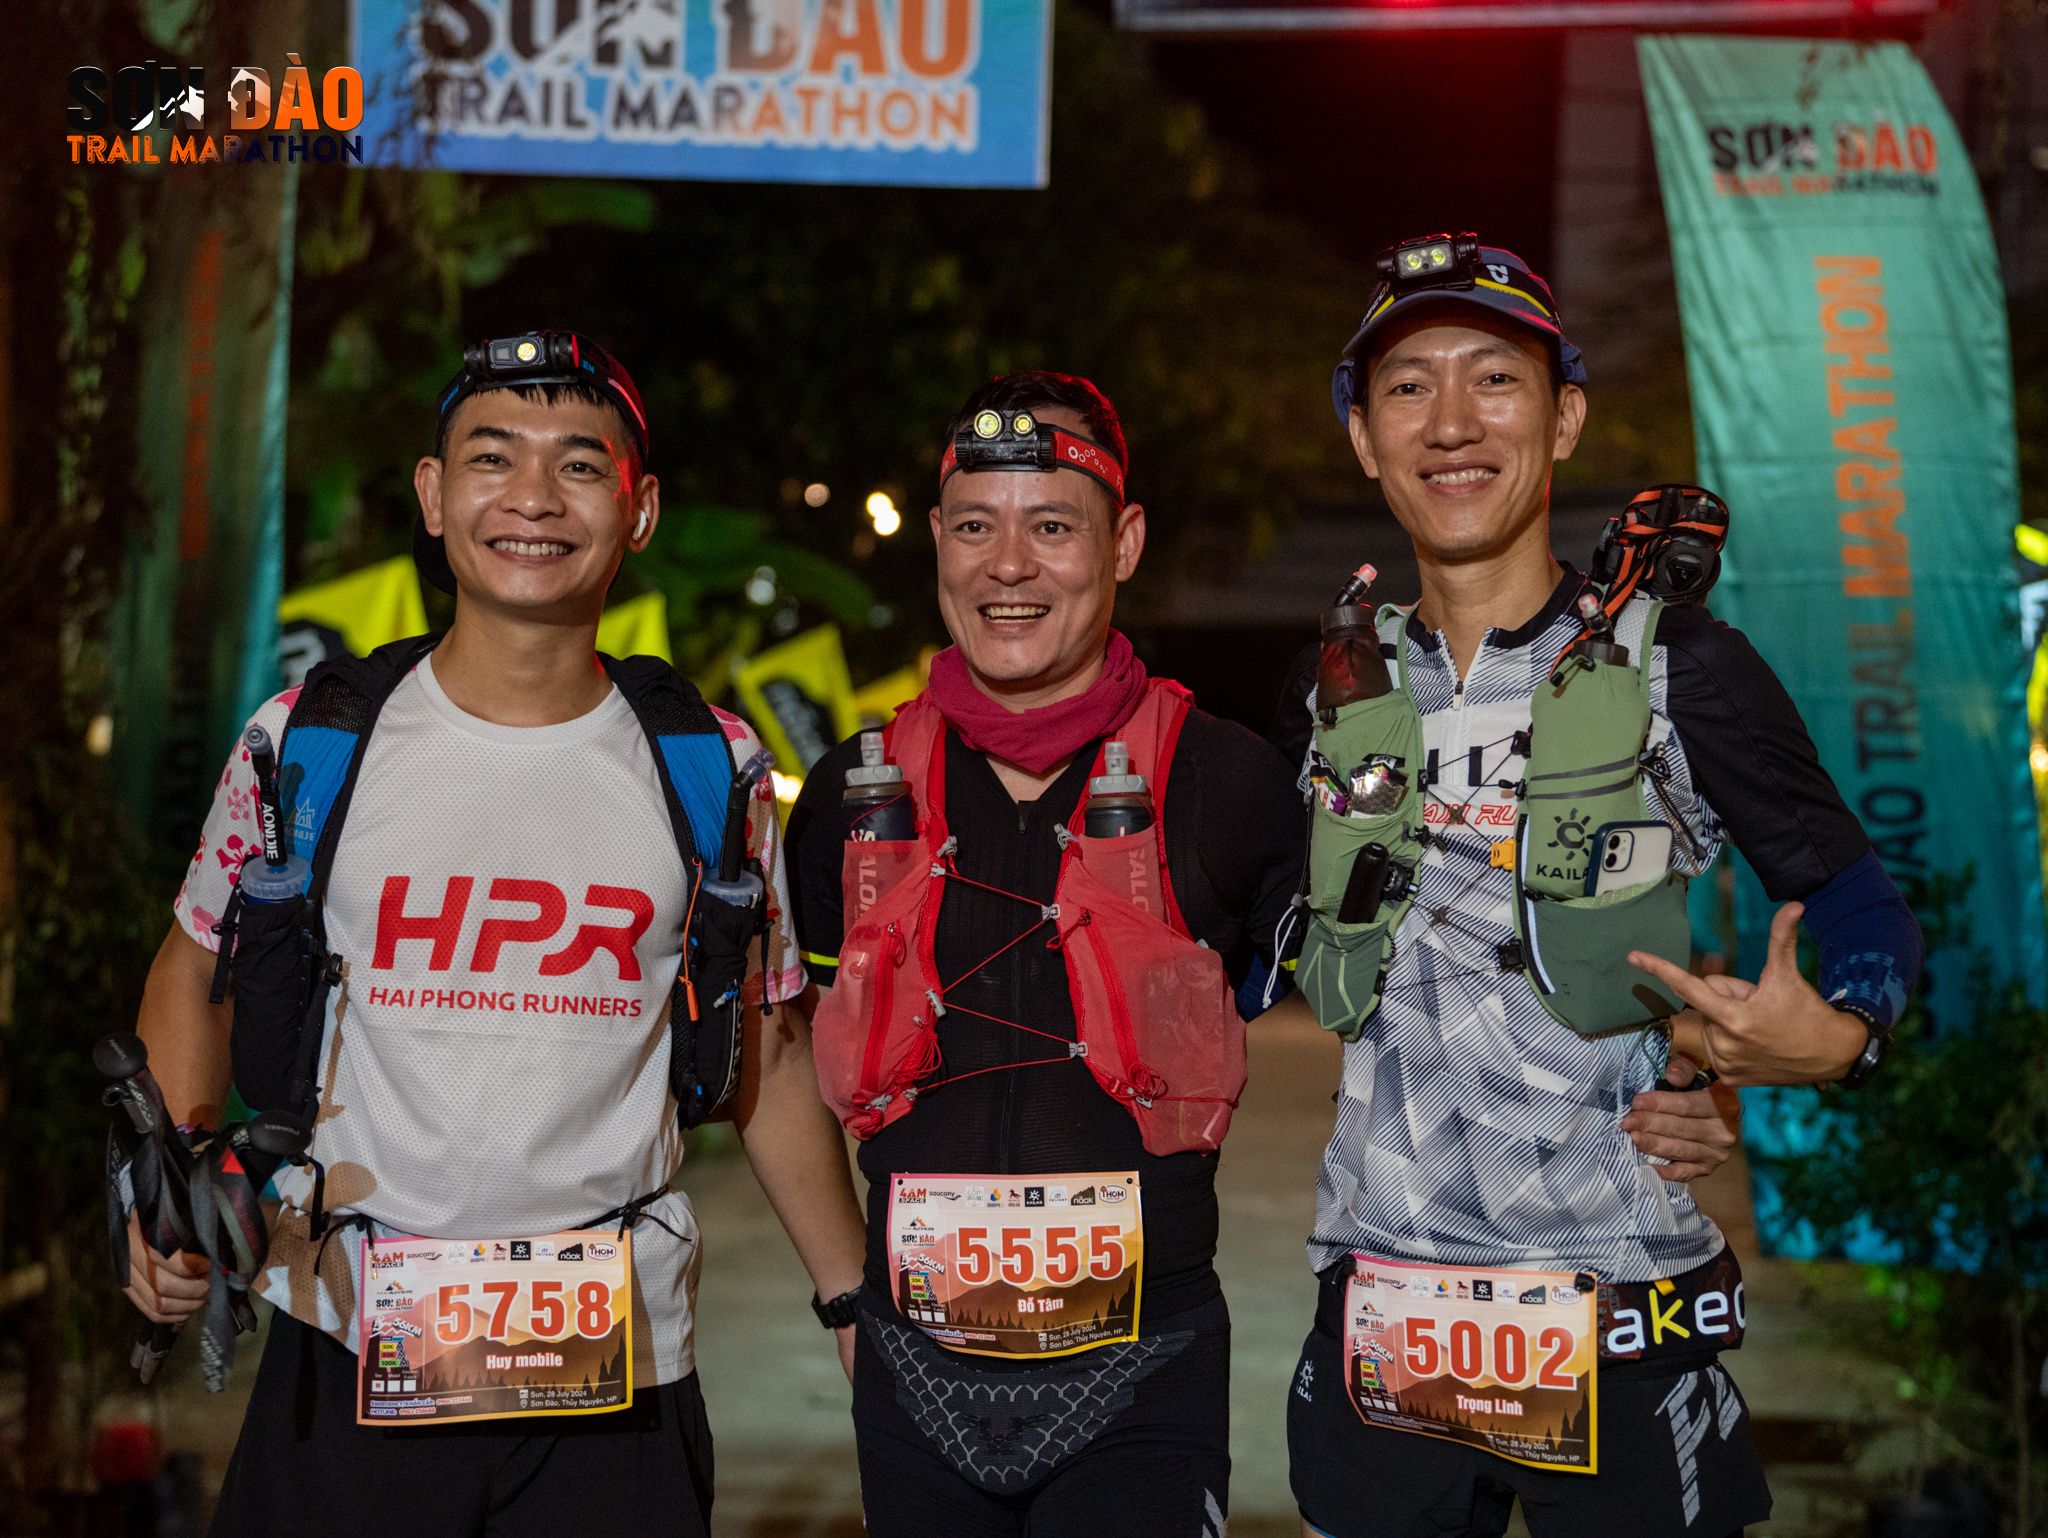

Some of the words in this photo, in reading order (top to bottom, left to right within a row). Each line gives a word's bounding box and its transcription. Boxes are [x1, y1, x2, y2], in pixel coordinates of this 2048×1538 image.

[422, 75, 588, 129] TRAIL
[612, 80, 969, 140] MARATHON
[1813, 255, 1912, 597] MARATHON
[1847, 608, 1919, 771] TRAIL
[262, 802, 278, 860] AONIJIE
[371, 876, 655, 981] HPR
[369, 987, 414, 1008] HAI
[420, 989, 515, 1011] PHONG
[523, 993, 642, 1017] RUNNERS
[899, 1188, 927, 1197] 4AM
[589, 1246, 614, 1256] THOM
[917, 1253, 945, 1273] 56KM
[956, 1223, 1125, 1286] 5555
[436, 1280, 613, 1343] 5758
[1017, 1297, 1035, 1313] Đỗ
[1037, 1297, 1064, 1312] Tâm
[392, 1317, 423, 1336] 56KM
[486, 1354, 512, 1370] Huy
[516, 1353, 563, 1368] mobile
[1403, 1317, 1577, 1391] 5002
[530, 1391, 546, 1399] Sun,
[556, 1391, 570, 1399] July
[1456, 1394, 1493, 1414] Trọng
[1494, 1399, 1523, 1416] Linh
[1519, 1442, 1532, 1450] July
